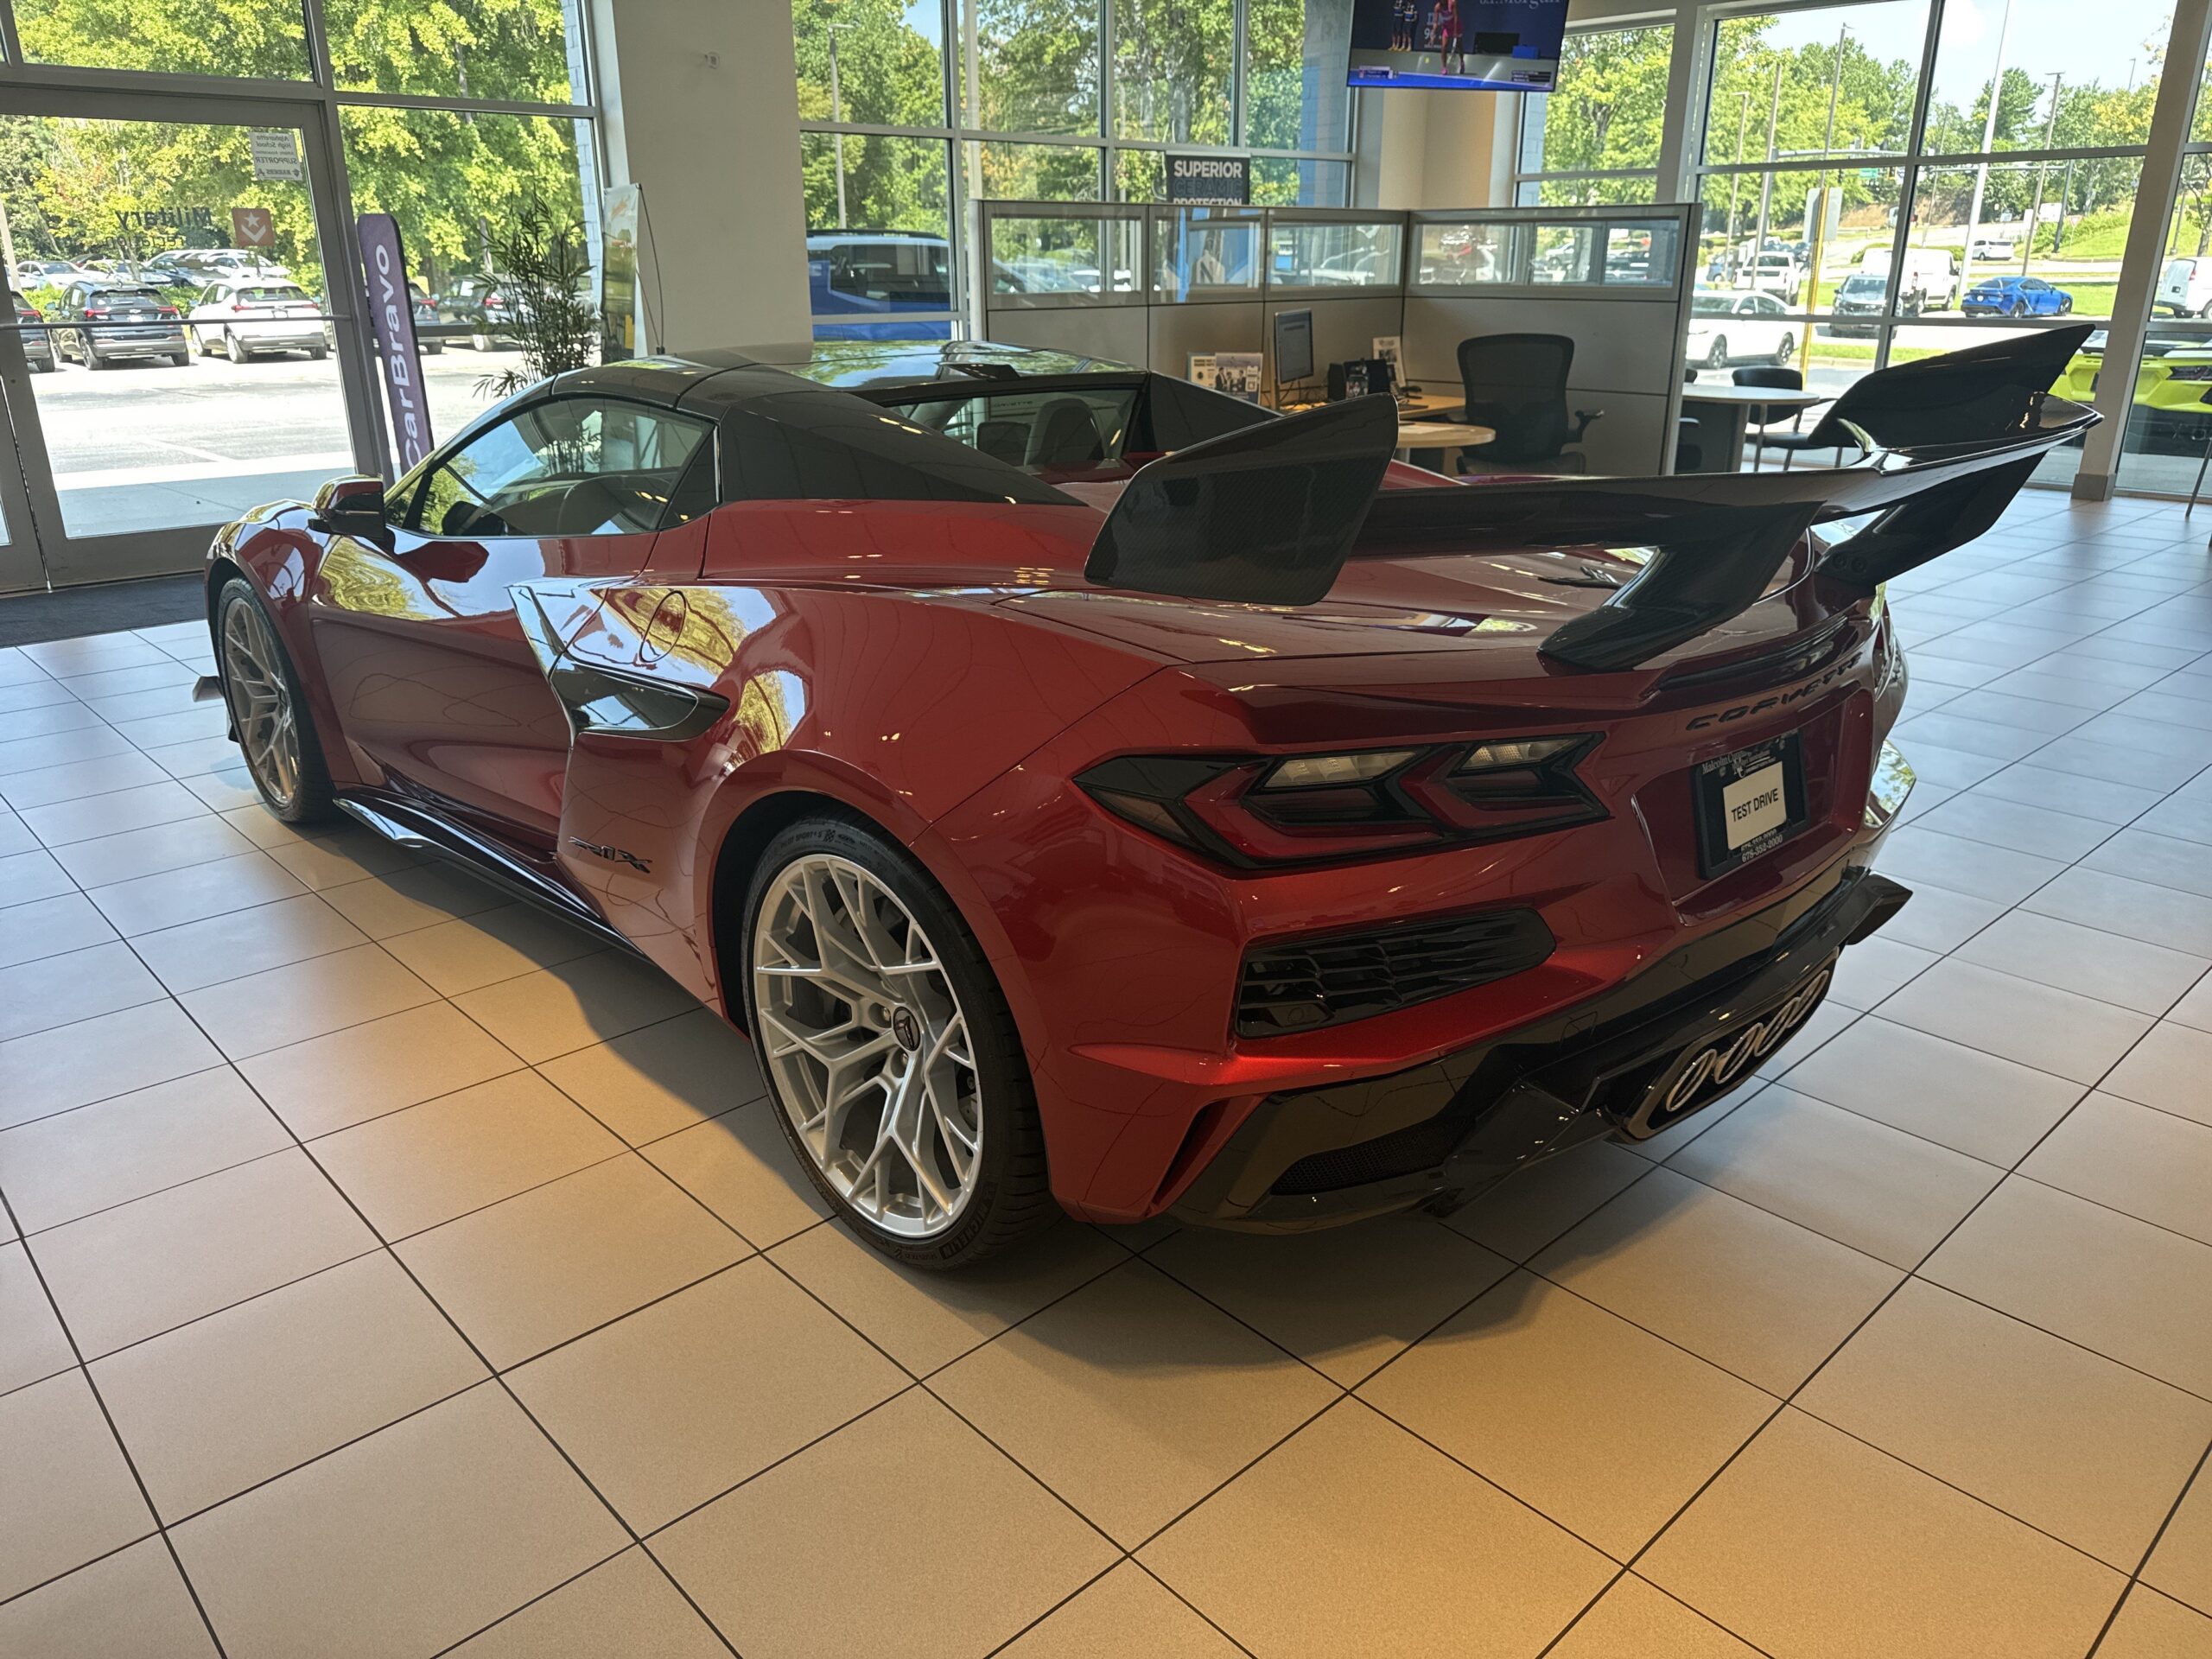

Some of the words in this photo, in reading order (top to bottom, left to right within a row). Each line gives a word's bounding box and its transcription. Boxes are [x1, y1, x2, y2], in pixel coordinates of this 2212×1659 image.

[1173, 159, 1243, 179] SUPERIOR
[1173, 178, 1243, 197] CERAMIC
[375, 244, 423, 471] CarBravo
[1685, 652, 1863, 731] CORVETTE
[1701, 753, 1729, 775] Malcolm
[1731, 800, 1751, 823] TEST
[1753, 788, 1779, 812] DRIVE
[1741, 834, 1783, 862] 678-352-2000
[943, 1201, 989, 1255] MICHELIN
